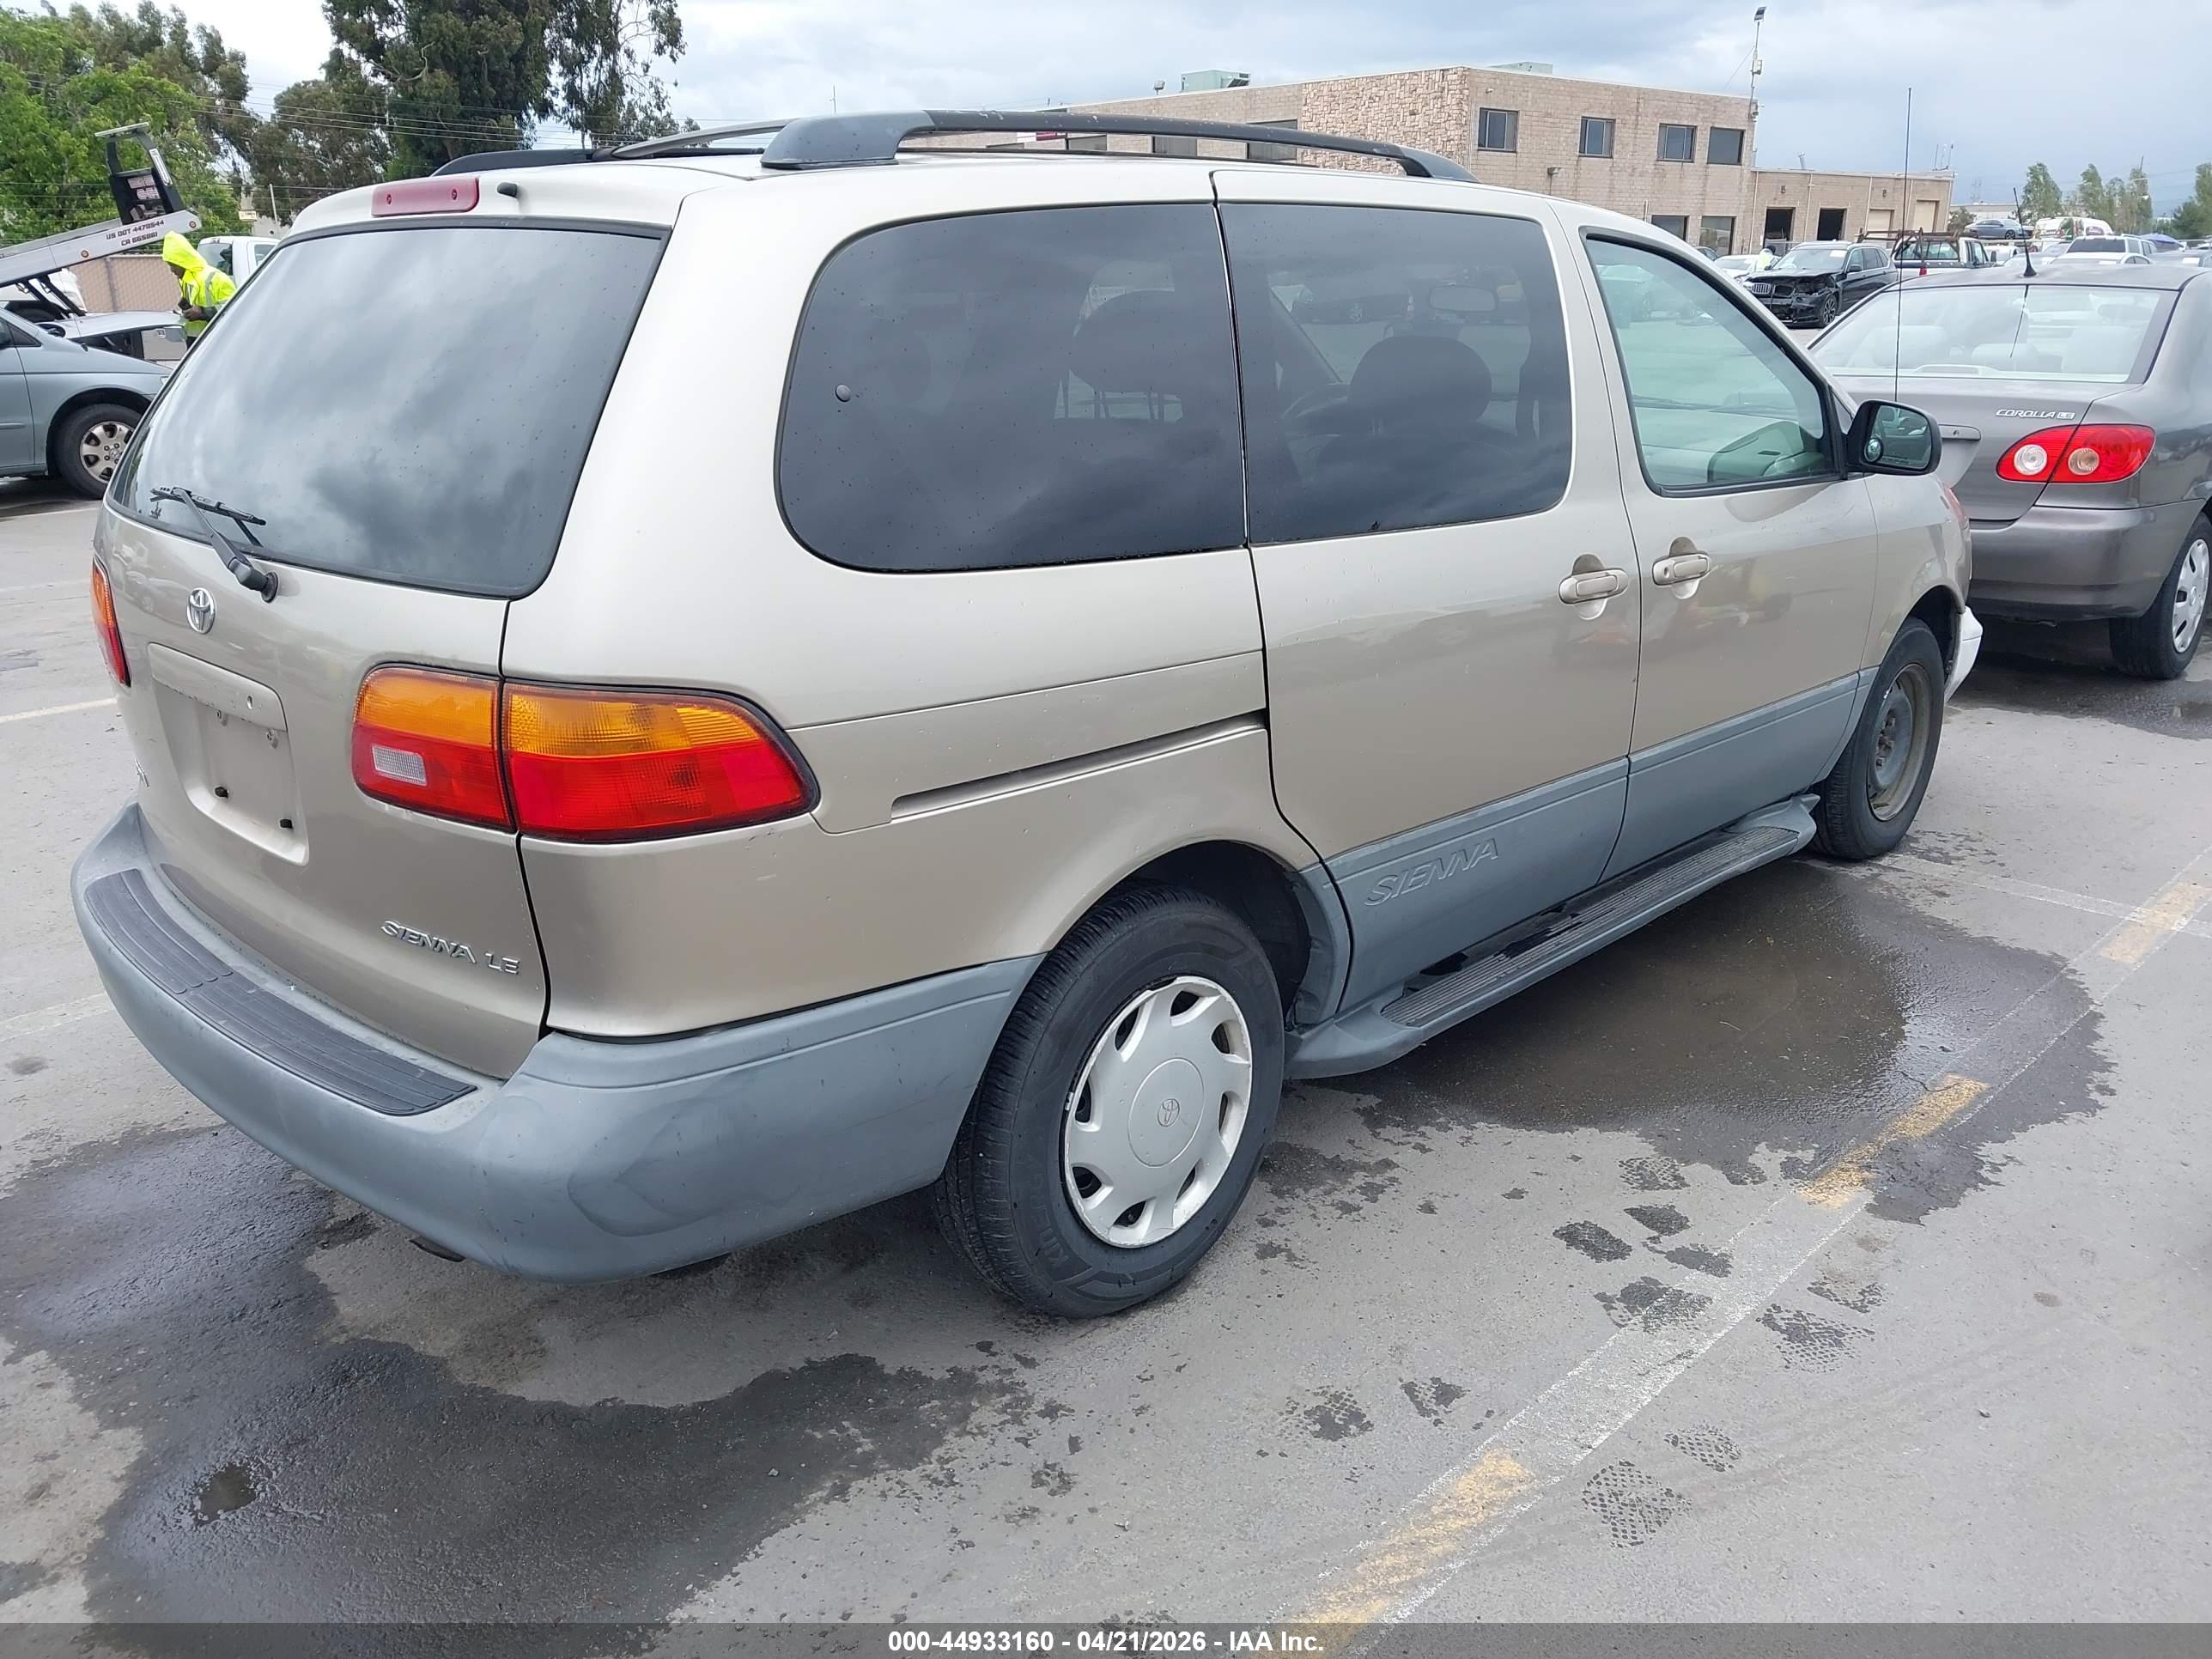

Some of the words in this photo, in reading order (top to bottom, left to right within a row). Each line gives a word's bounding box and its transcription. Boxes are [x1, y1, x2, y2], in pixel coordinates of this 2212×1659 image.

[117, 228, 131, 237] DOT
[1995, 409, 2056, 419] COROLLA
[1364, 838, 1498, 907] SIENNA
[380, 920, 477, 964] SIENNA
[484, 951, 521, 975] LE
